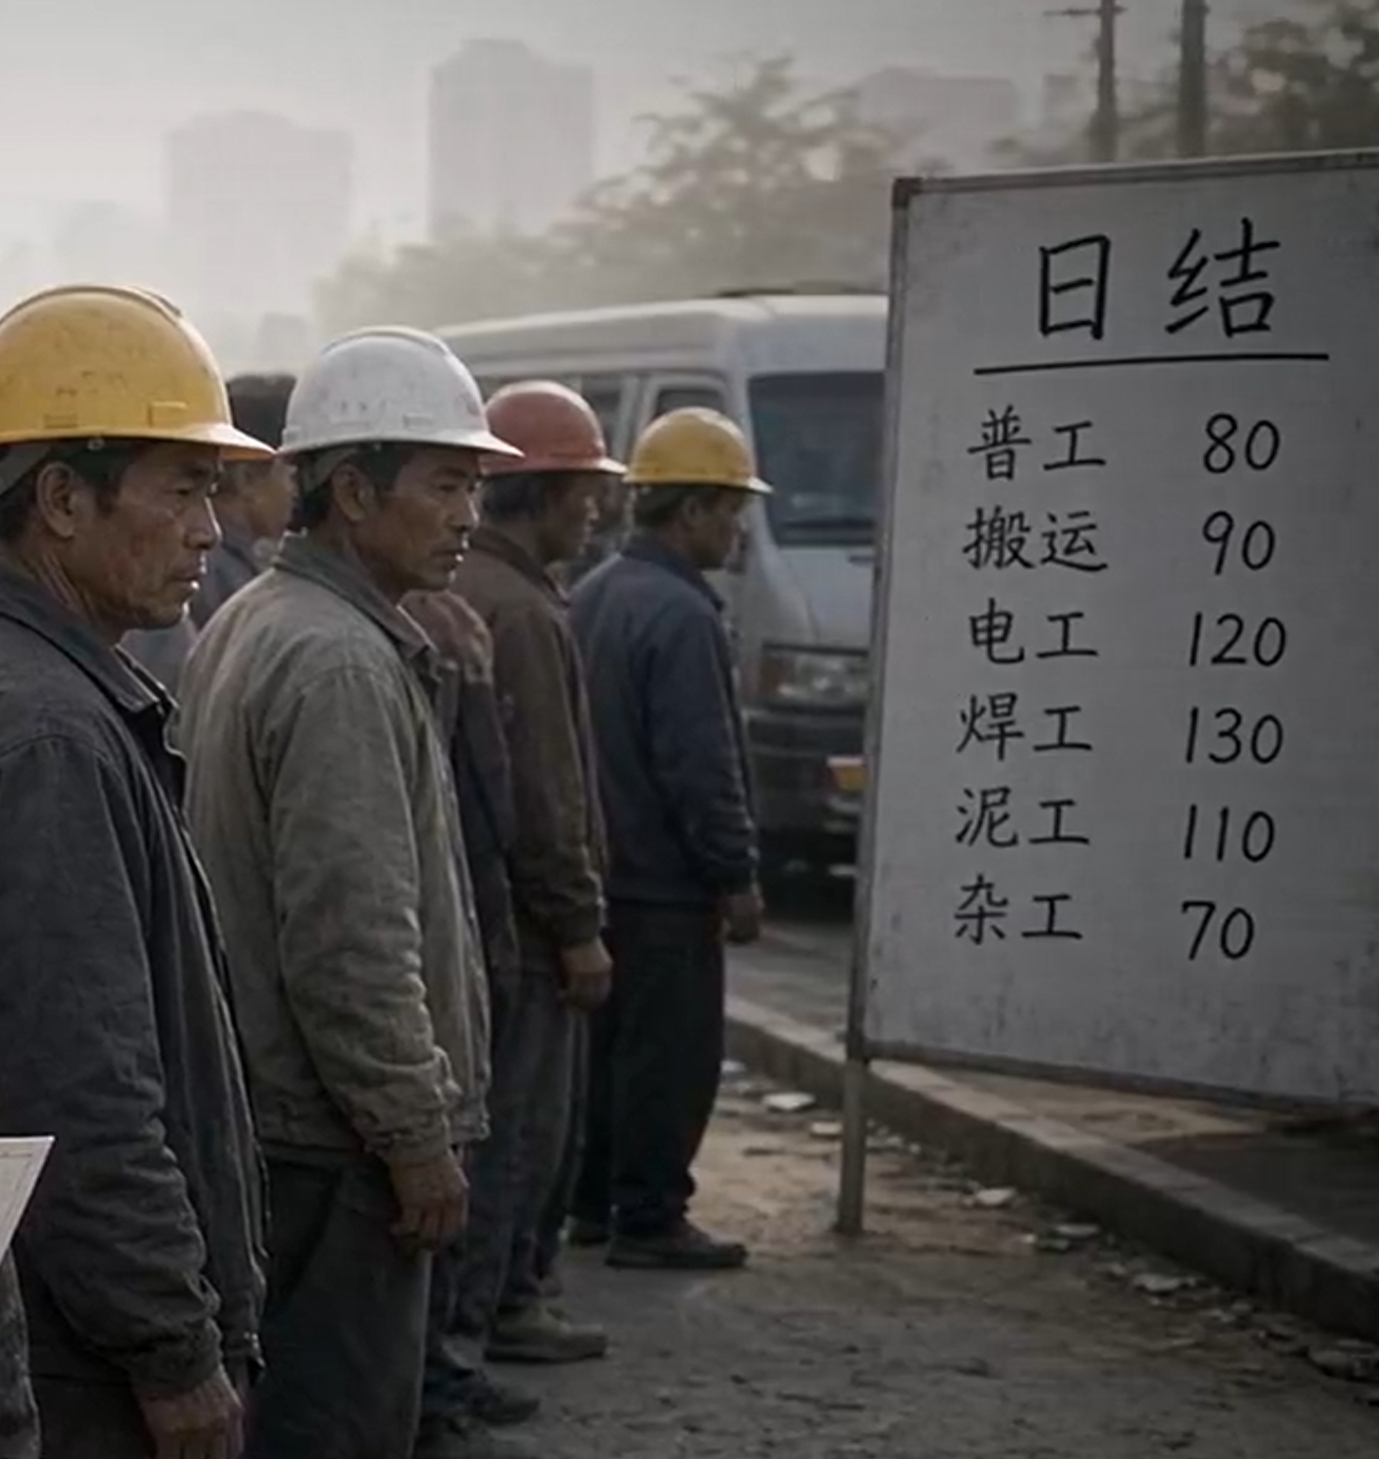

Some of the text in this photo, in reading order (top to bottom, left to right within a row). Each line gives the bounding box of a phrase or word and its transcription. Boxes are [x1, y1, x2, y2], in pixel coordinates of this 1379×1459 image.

[1038, 216, 1282, 341] 日结
[967, 404, 1281, 481] 普工 80
[961, 505, 1277, 576] 搬运 90
[968, 597, 1288, 668] 电工 120
[956, 691, 1285, 765] 焊工 130
[955, 785, 1276, 864] 泥工 110
[954, 873, 1256, 962] 杂工 70
